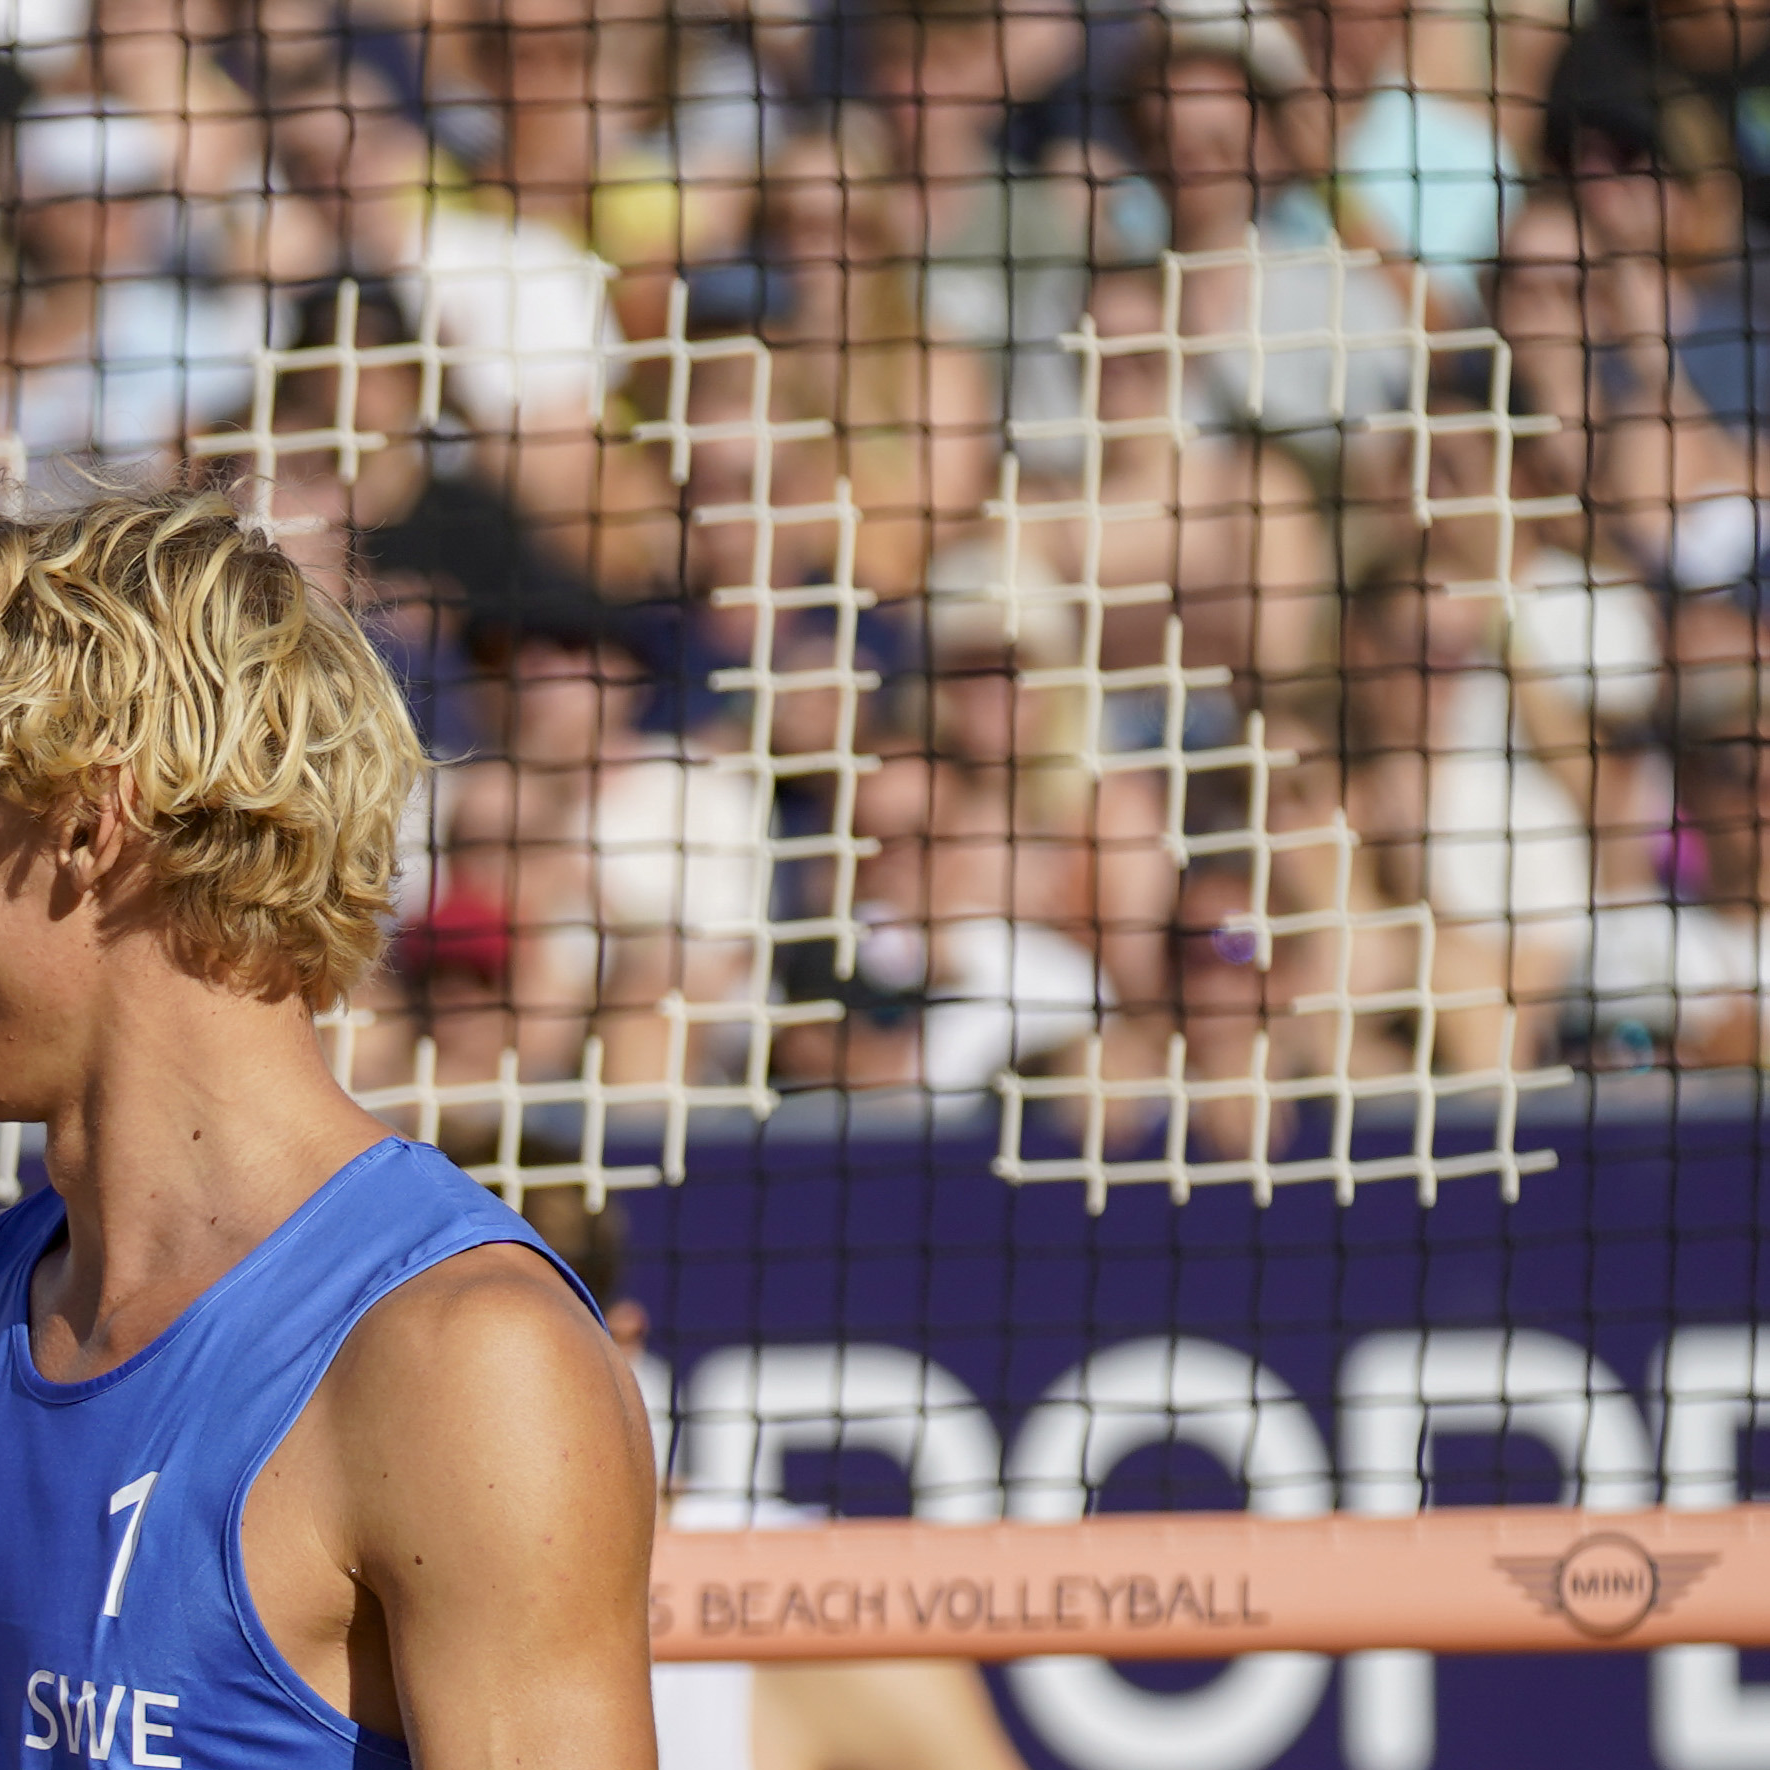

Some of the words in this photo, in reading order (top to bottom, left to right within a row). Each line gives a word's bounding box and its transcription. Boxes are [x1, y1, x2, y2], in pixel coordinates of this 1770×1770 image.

[105, 1471, 159, 1617] 1
[1572, 1567, 1646, 1598] MINI
[700, 1576, 887, 1637] BEACH
[906, 1572, 1271, 1632] VOLLEYBALL
[25, 1670, 181, 1769] SWE
